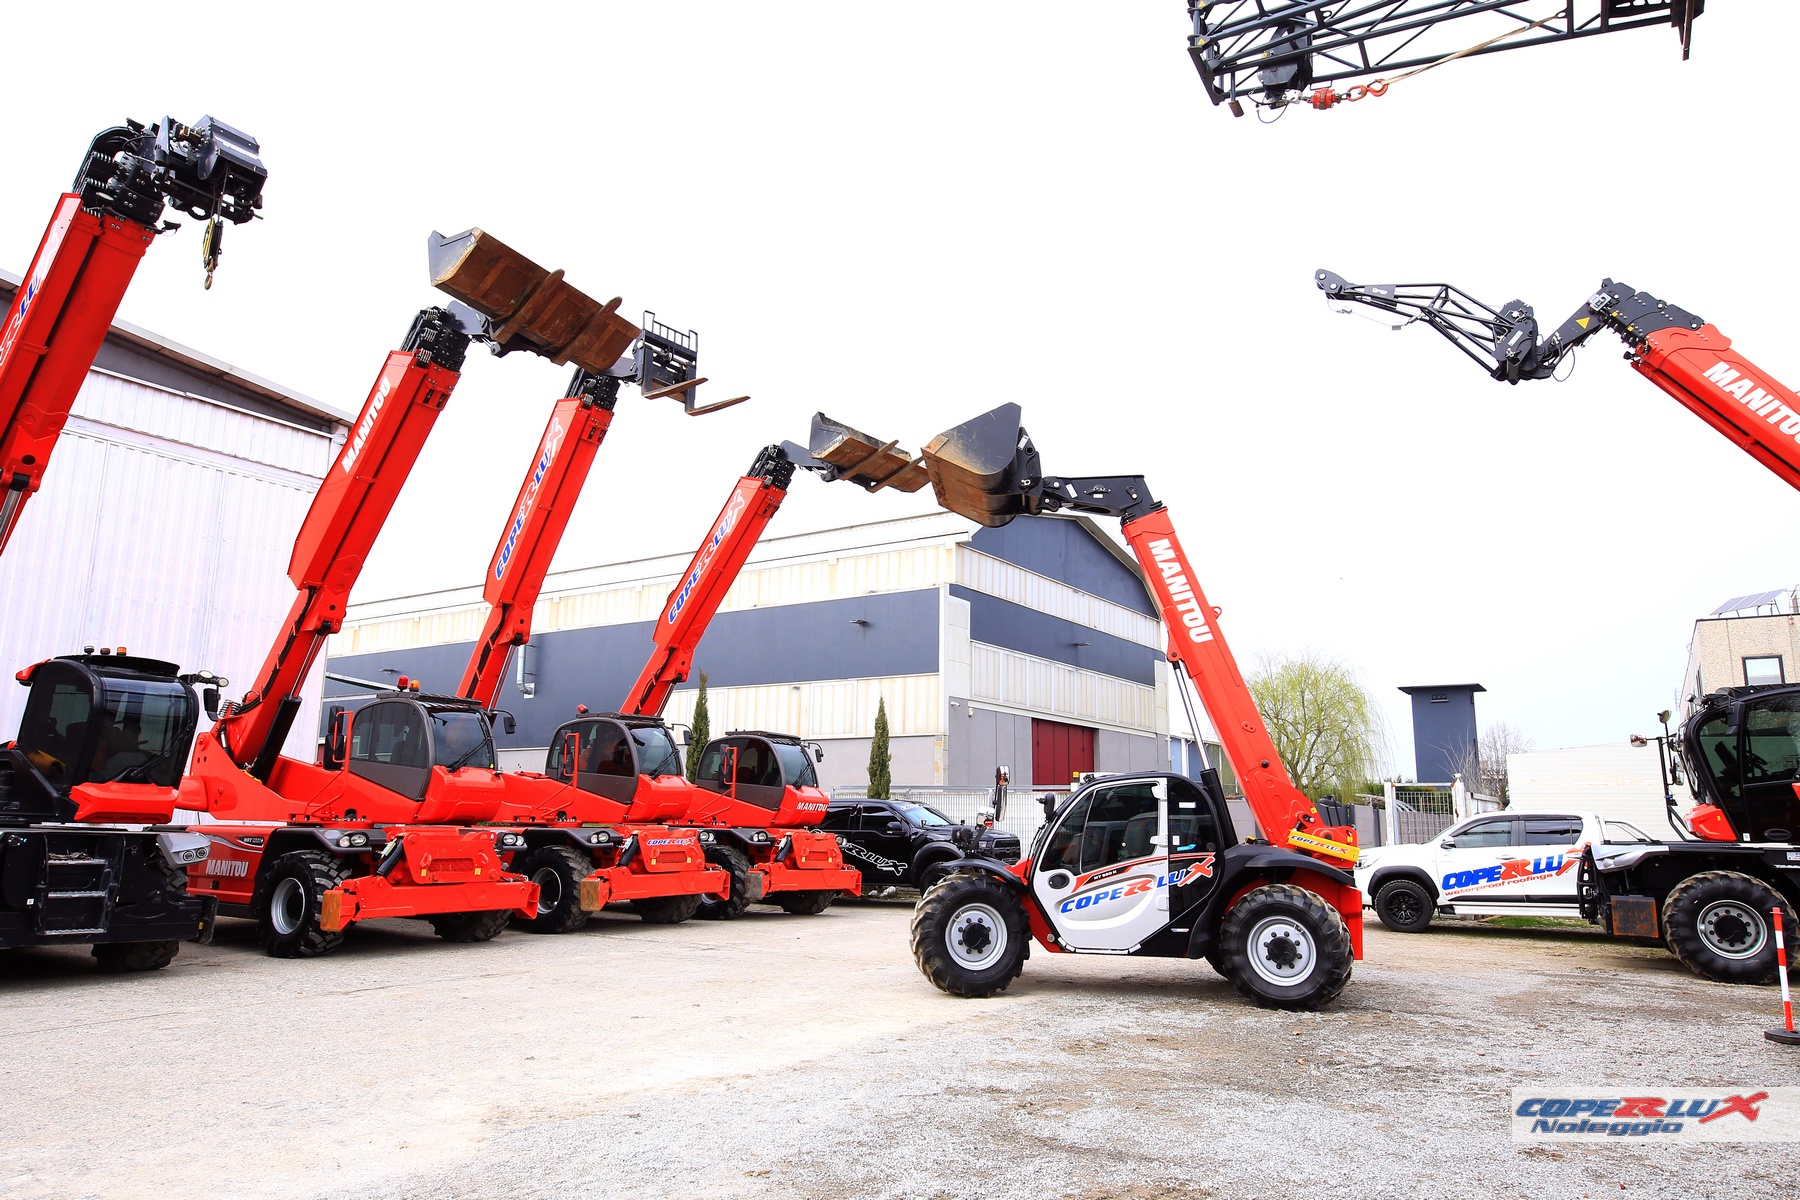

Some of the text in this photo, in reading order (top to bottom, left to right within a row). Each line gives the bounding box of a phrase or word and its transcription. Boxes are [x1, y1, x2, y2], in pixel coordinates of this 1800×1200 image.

[341, 376, 391, 474] MANITOU
[1702, 361, 1800, 444] MANITO
[495, 417, 563, 580] COPERLUX
[668, 489, 745, 625] COPERLUX
[1148, 538, 1215, 643] MANITOU
[796, 802, 829, 811] MANITOU
[206, 860, 249, 878] MANITOU
[1291, 835, 1349, 855] COPERLUX
[1060, 857, 1215, 914] COPERLUX
[1445, 873, 1553, 896] waterproof roofings
